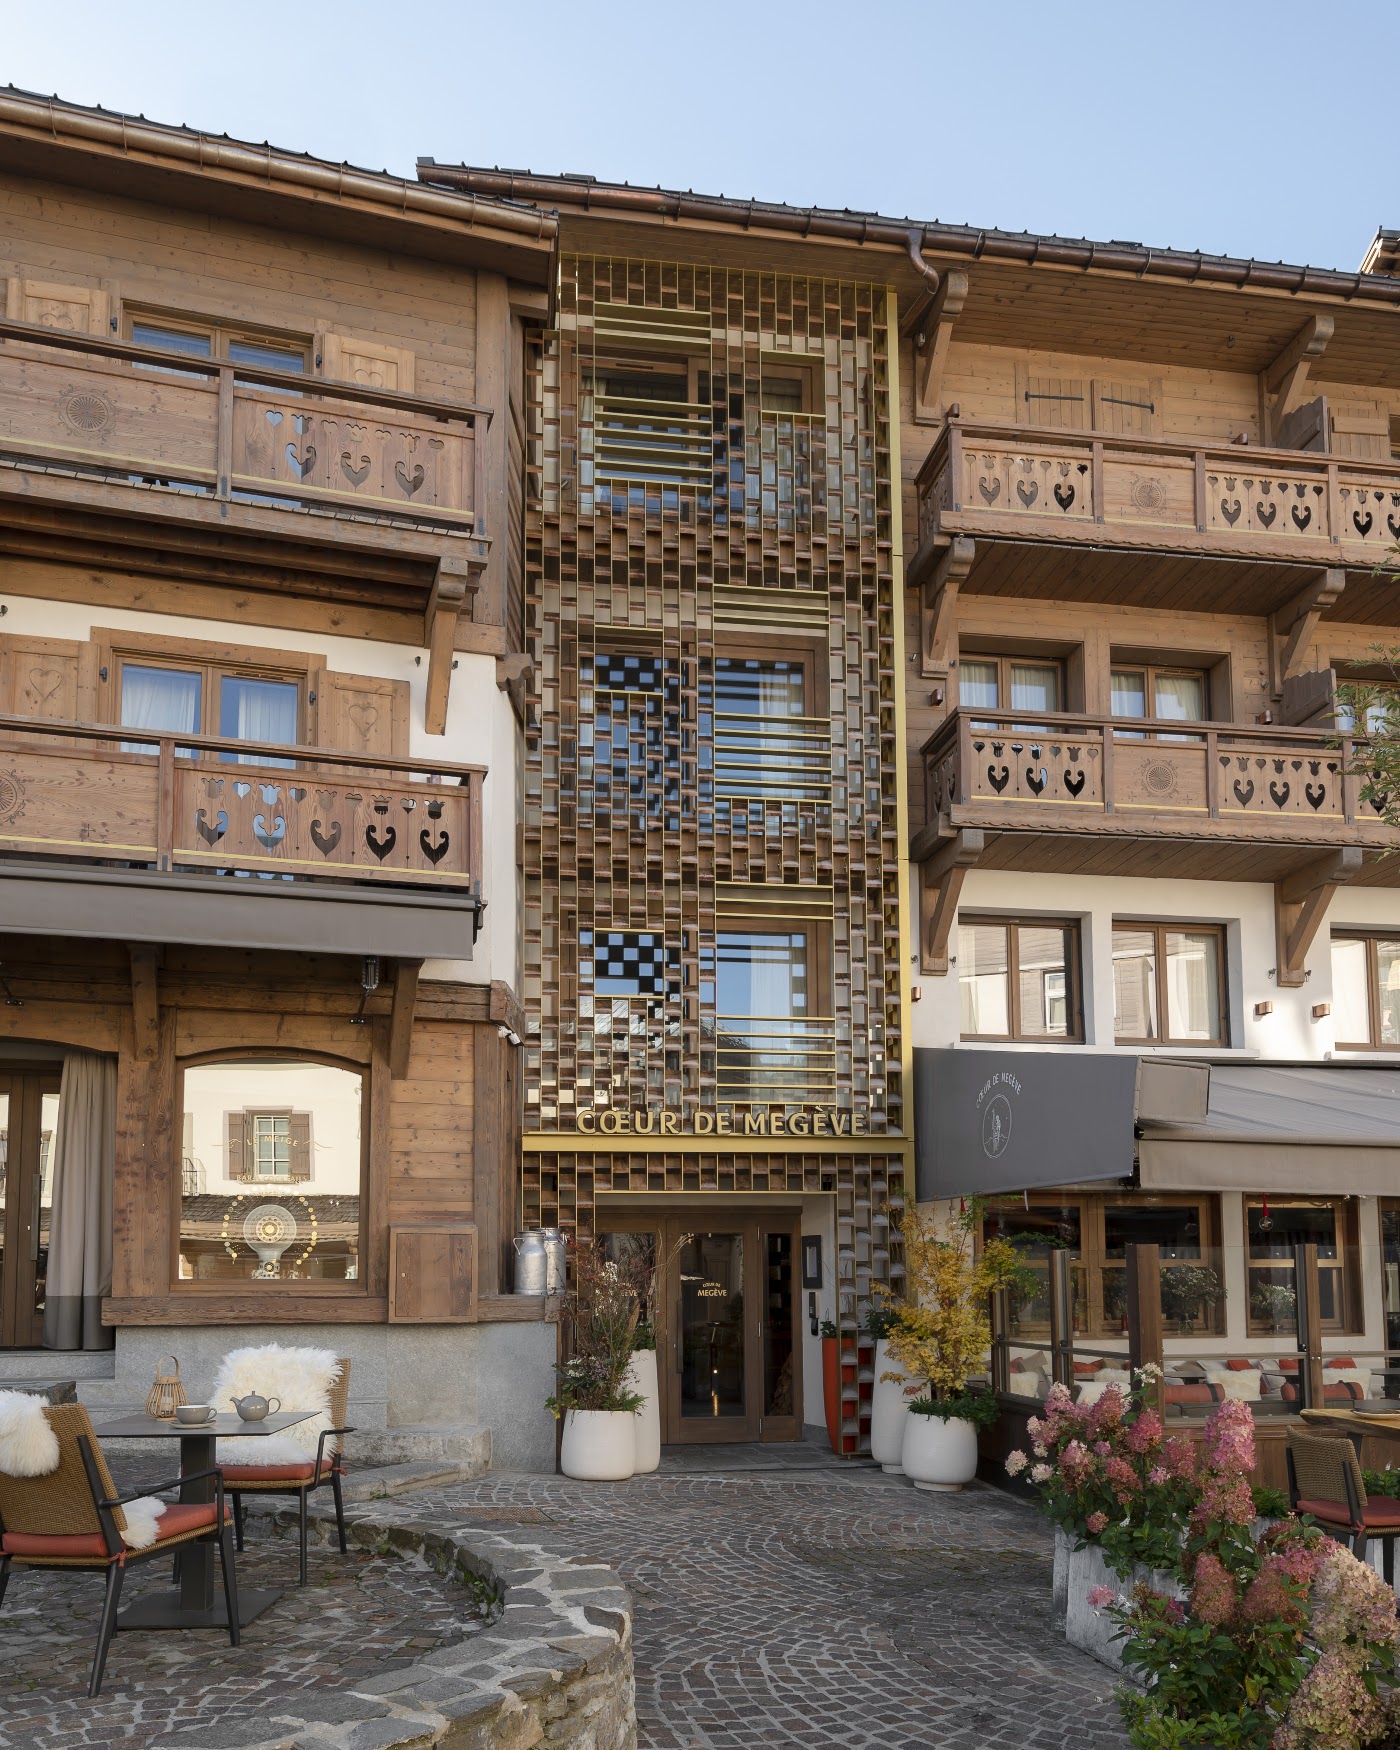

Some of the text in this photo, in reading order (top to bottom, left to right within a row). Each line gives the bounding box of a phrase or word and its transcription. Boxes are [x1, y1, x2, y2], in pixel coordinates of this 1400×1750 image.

[992, 1073, 999, 1085] DE
[577, 1105, 867, 1136] CŒUR DE MEGÈVE
[246, 1135, 299, 1147] LE MEIGE
[697, 1288, 727, 1297] MEGÈVE
